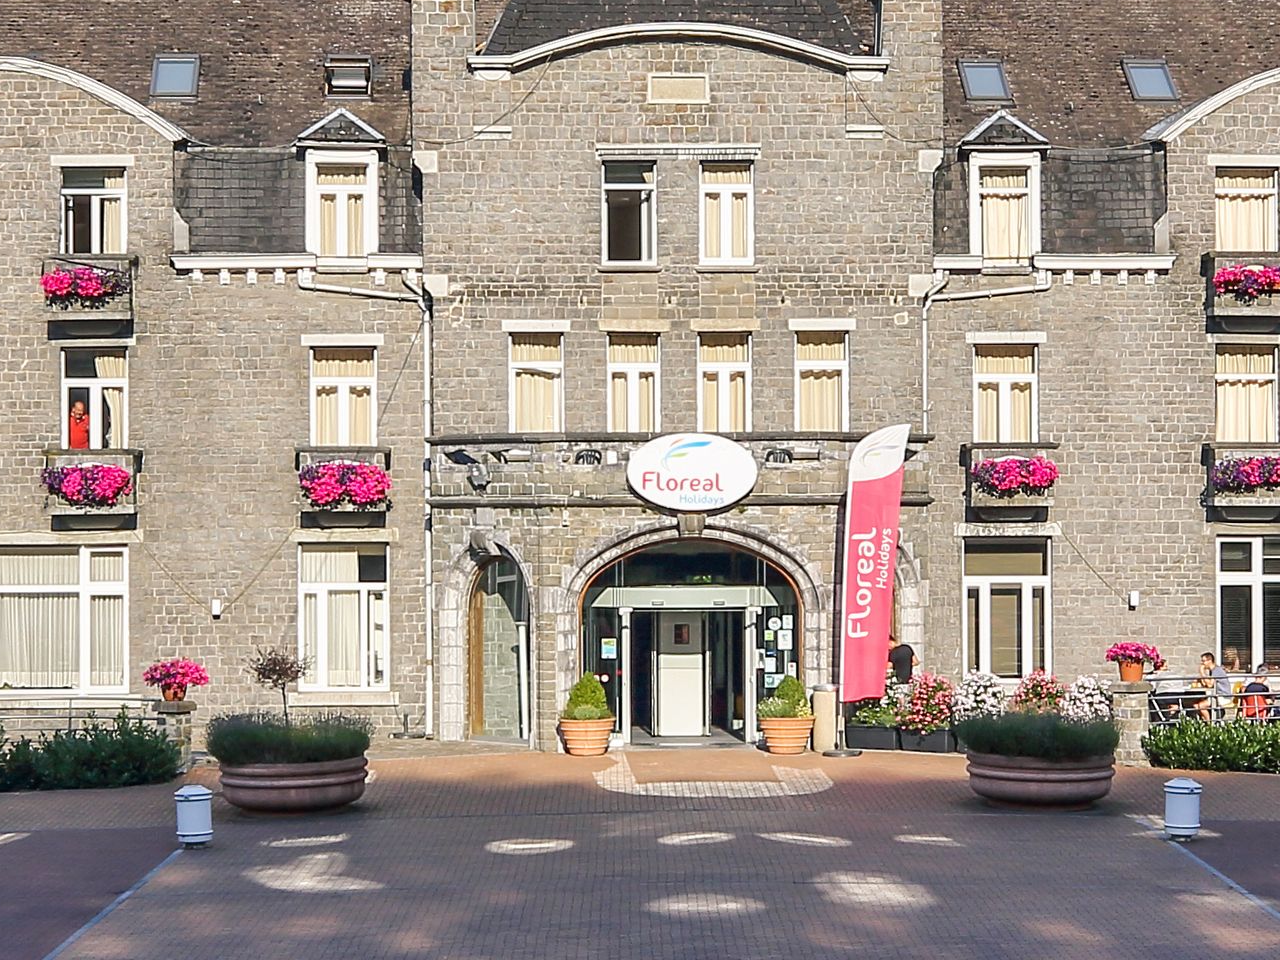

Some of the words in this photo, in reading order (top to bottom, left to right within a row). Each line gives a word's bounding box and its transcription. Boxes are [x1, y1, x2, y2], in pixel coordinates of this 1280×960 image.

[642, 471, 724, 492] Floreal
[680, 494, 724, 506] Holidays
[875, 528, 893, 589] Holidays
[847, 527, 877, 638] Floreal
